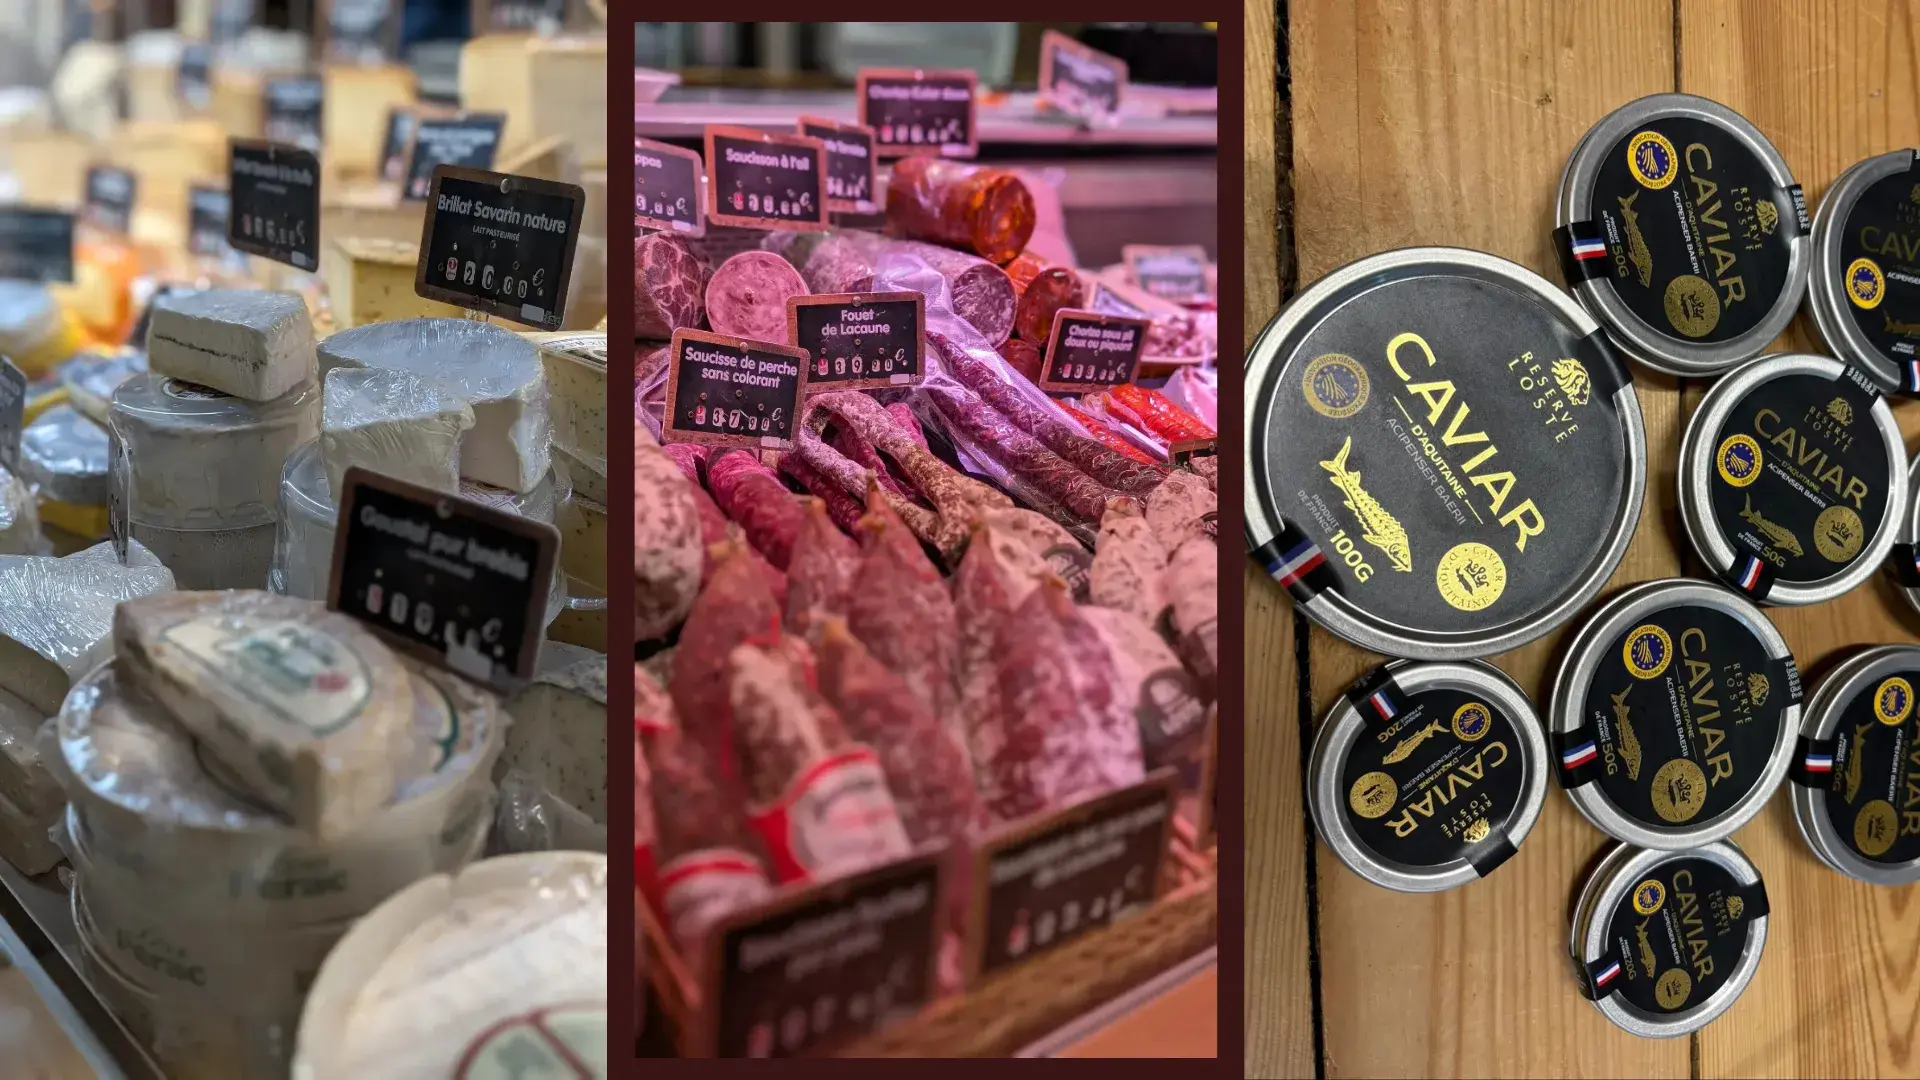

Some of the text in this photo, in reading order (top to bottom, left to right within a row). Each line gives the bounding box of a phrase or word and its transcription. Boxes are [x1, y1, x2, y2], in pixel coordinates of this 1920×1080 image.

[726, 148, 779, 168] Saucisson
[437, 193, 567, 234] Brillat Savarin nature
[472, 225, 520, 242] LAIT PASTEURISÉ
[1672, 190, 1701, 275] ACIPENSER BAERII
[1684, 142, 1747, 309] CAVIAR
[1730, 188, 1754, 251] LOSTE
[1740, 187, 1763, 250] RESERVE
[532, 268, 545, 287] €
[1611, 245, 1629, 278] 50G
[822, 323, 891, 336] de Lacaune
[841, 309, 875, 321] Fouet
[685, 346, 798, 376] Saucisse de perche
[895, 348, 905, 361] €
[1064, 336, 1087, 348] doux
[1087, 340, 1100, 349] ou
[701, 367, 781, 389] sans colorant
[1521, 350, 1579, 436] RESERVE
[771, 407, 782, 421] €
[1508, 358, 1567, 443] LOSTE
[1386, 332, 1545, 553] CAVIAR
[1803, 415, 1850, 453] LOSTE
[1809, 405, 1854, 445] RESERVE
[1387, 418, 1466, 525] ACIPENSER BAERII
[1411, 424, 1467, 500] D'AQUITAINE
[1754, 408, 1868, 511] CAVIAR
[1767, 462, 1827, 509] ACIPENSER BAERII
[1297, 490, 1333, 534] DE FRANCE
[1312, 494, 1340, 529] PRODUIT
[1329, 528, 1374, 583] 100G
[1474, 546, 1503, 583] CAVIAR
[1761, 546, 1786, 568] 50G
[1677, 685, 1695, 740] D'AQUITAINE
[1680, 627, 1734, 787] CAVIAR
[1723, 665, 1745, 726] LOSTE
[1733, 662, 1752, 724] RESERVE
[1377, 722, 1403, 743] 20G
[1665, 676, 1689, 757] ACIPENSER BAERII
[1402, 744, 1462, 791] ACIPENSER BAERII
[1602, 742, 1618, 776] 50G
[1385, 741, 1508, 838] CAVIAR
[1440, 792, 1486, 830] LOSTE
[1447, 801, 1493, 838] RESERVE
[1672, 869, 1716, 983] CAVIAR
